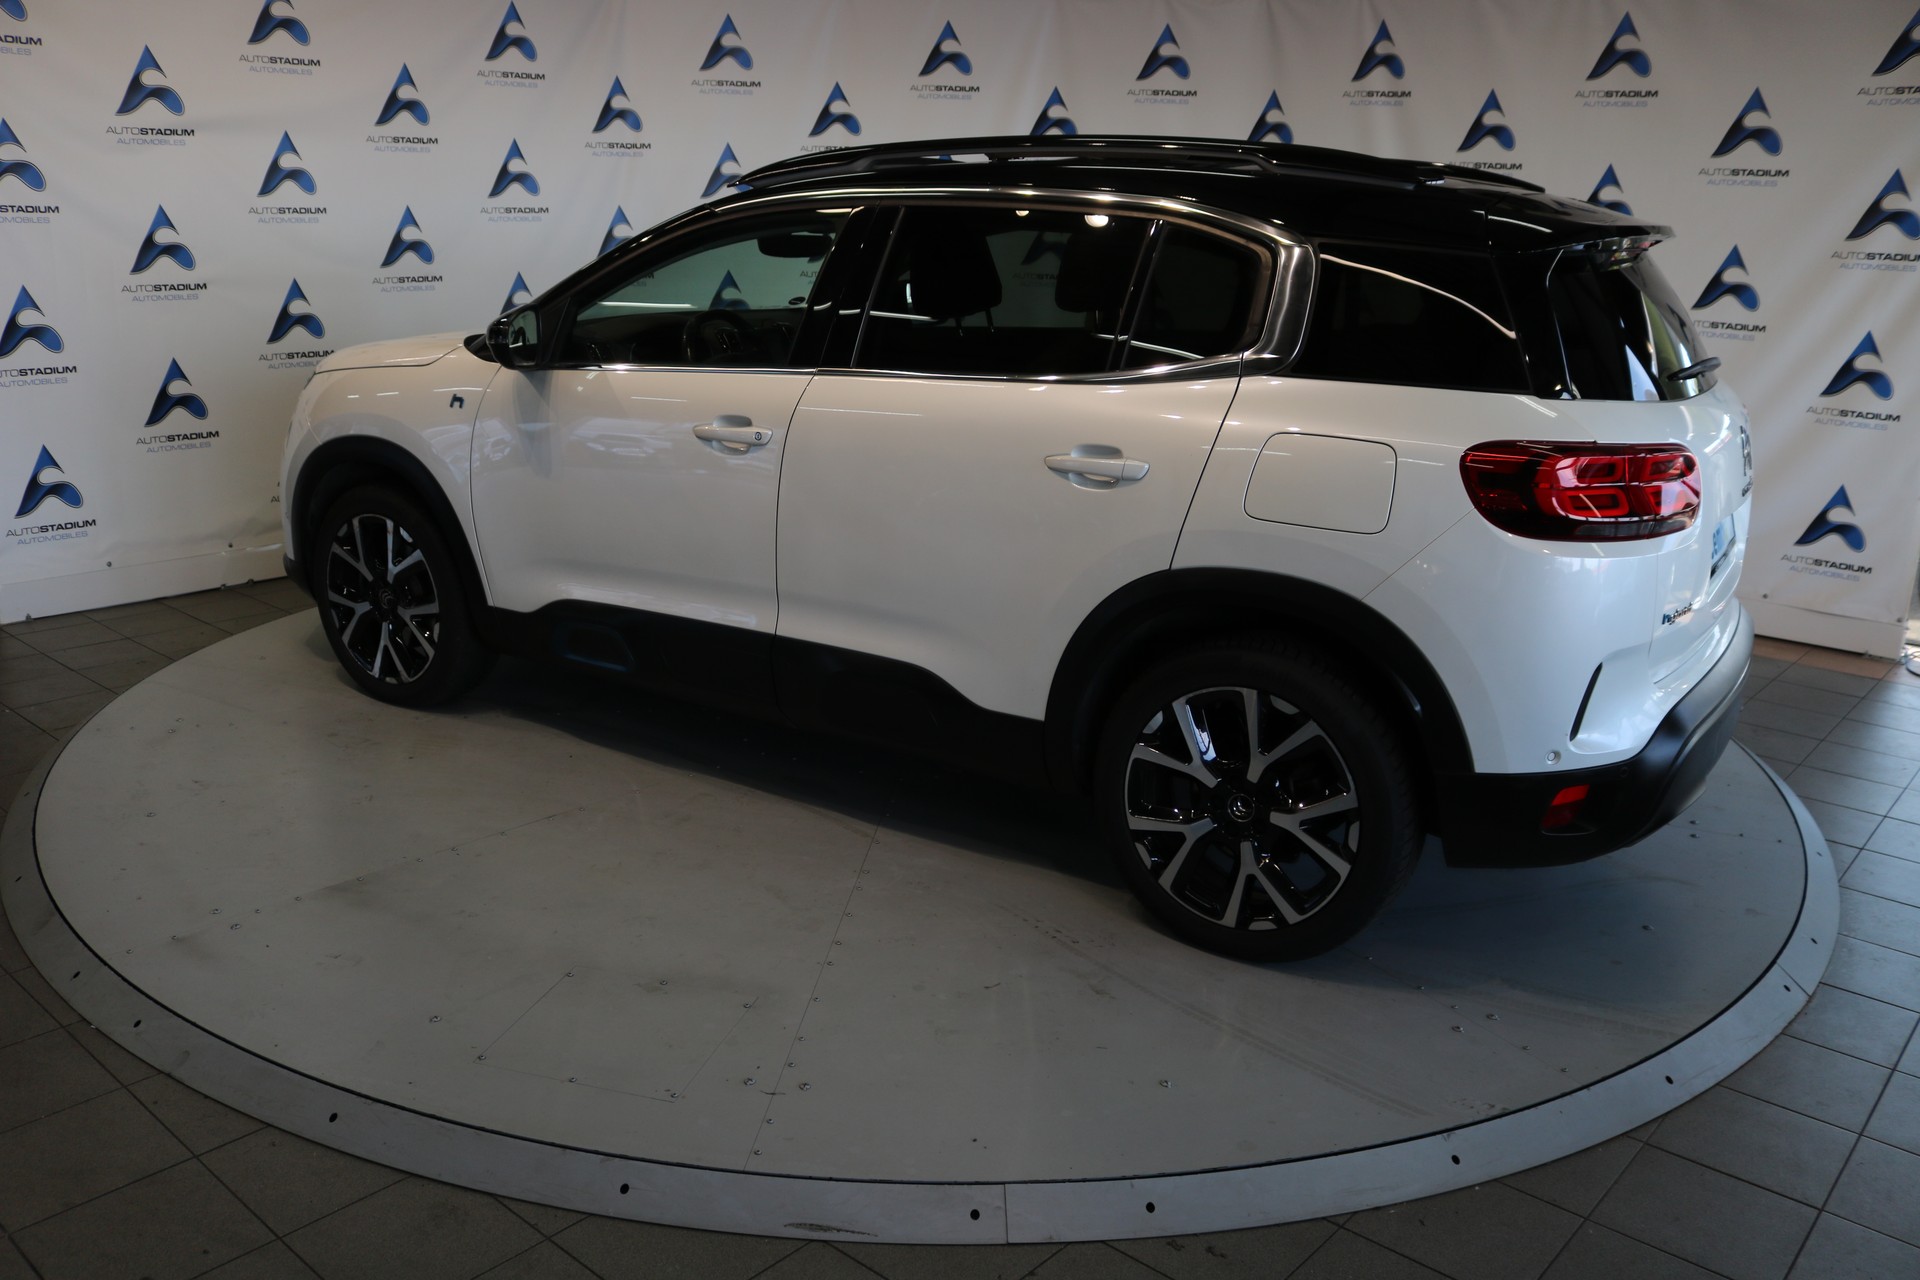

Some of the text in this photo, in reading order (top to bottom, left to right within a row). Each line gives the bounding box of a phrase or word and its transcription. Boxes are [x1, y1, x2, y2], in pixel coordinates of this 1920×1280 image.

[239, 54, 320, 66] AUTOSTADIUM
[249, 66, 312, 75] AUTOMOBILES
[477, 70, 545, 80] AUTOSTADIUM
[691, 79, 761, 87] AUTOSTADIUM
[910, 84, 980, 92] AUTOSTADIUM
[1127, 88, 1197, 97] AUTOSTADIUM
[1343, 89, 1411, 98] AUTOSTADIUM
[1575, 90, 1658, 98] AUTOSTADIUM
[106, 126, 195, 136] AUTOSTADIUM
[117, 138, 186, 146] AUTOMOBILES
[366, 136, 438, 144] AUTOSTADIUM
[585, 142, 651, 150] AUTOSTADIUM
[1699, 168, 1790, 178] AUTOSTADIUM
[1707, 179, 1778, 188] AUTOMOBILES
[248, 207, 326, 215] AUTOSTADIUM
[1831, 250, 1920, 261] AUTOSTADIU
[1840, 263, 1916, 271] AUTOMOBILES
[372, 276, 443, 284] AUTOSTADIUM
[121, 283, 207, 292] AUTOSTADIUM
[132, 293, 199, 302] AUTOMOBILES
[1807, 405, 1900, 423] AUTOSTADIUM
[1815, 417, 1888, 430] AUTOMOBILES
[136, 431, 219, 445] AUTOSTADIUM
[146, 441, 211, 453] AUTOMOBILES
[6, 519, 96, 537] AUTOSTADIUM
[17, 531, 88, 545] AUTOMOBILES
[1781, 554, 1872, 574] AUTOSTADIUM
[1789, 565, 1860, 582] AUTOMOBILES
